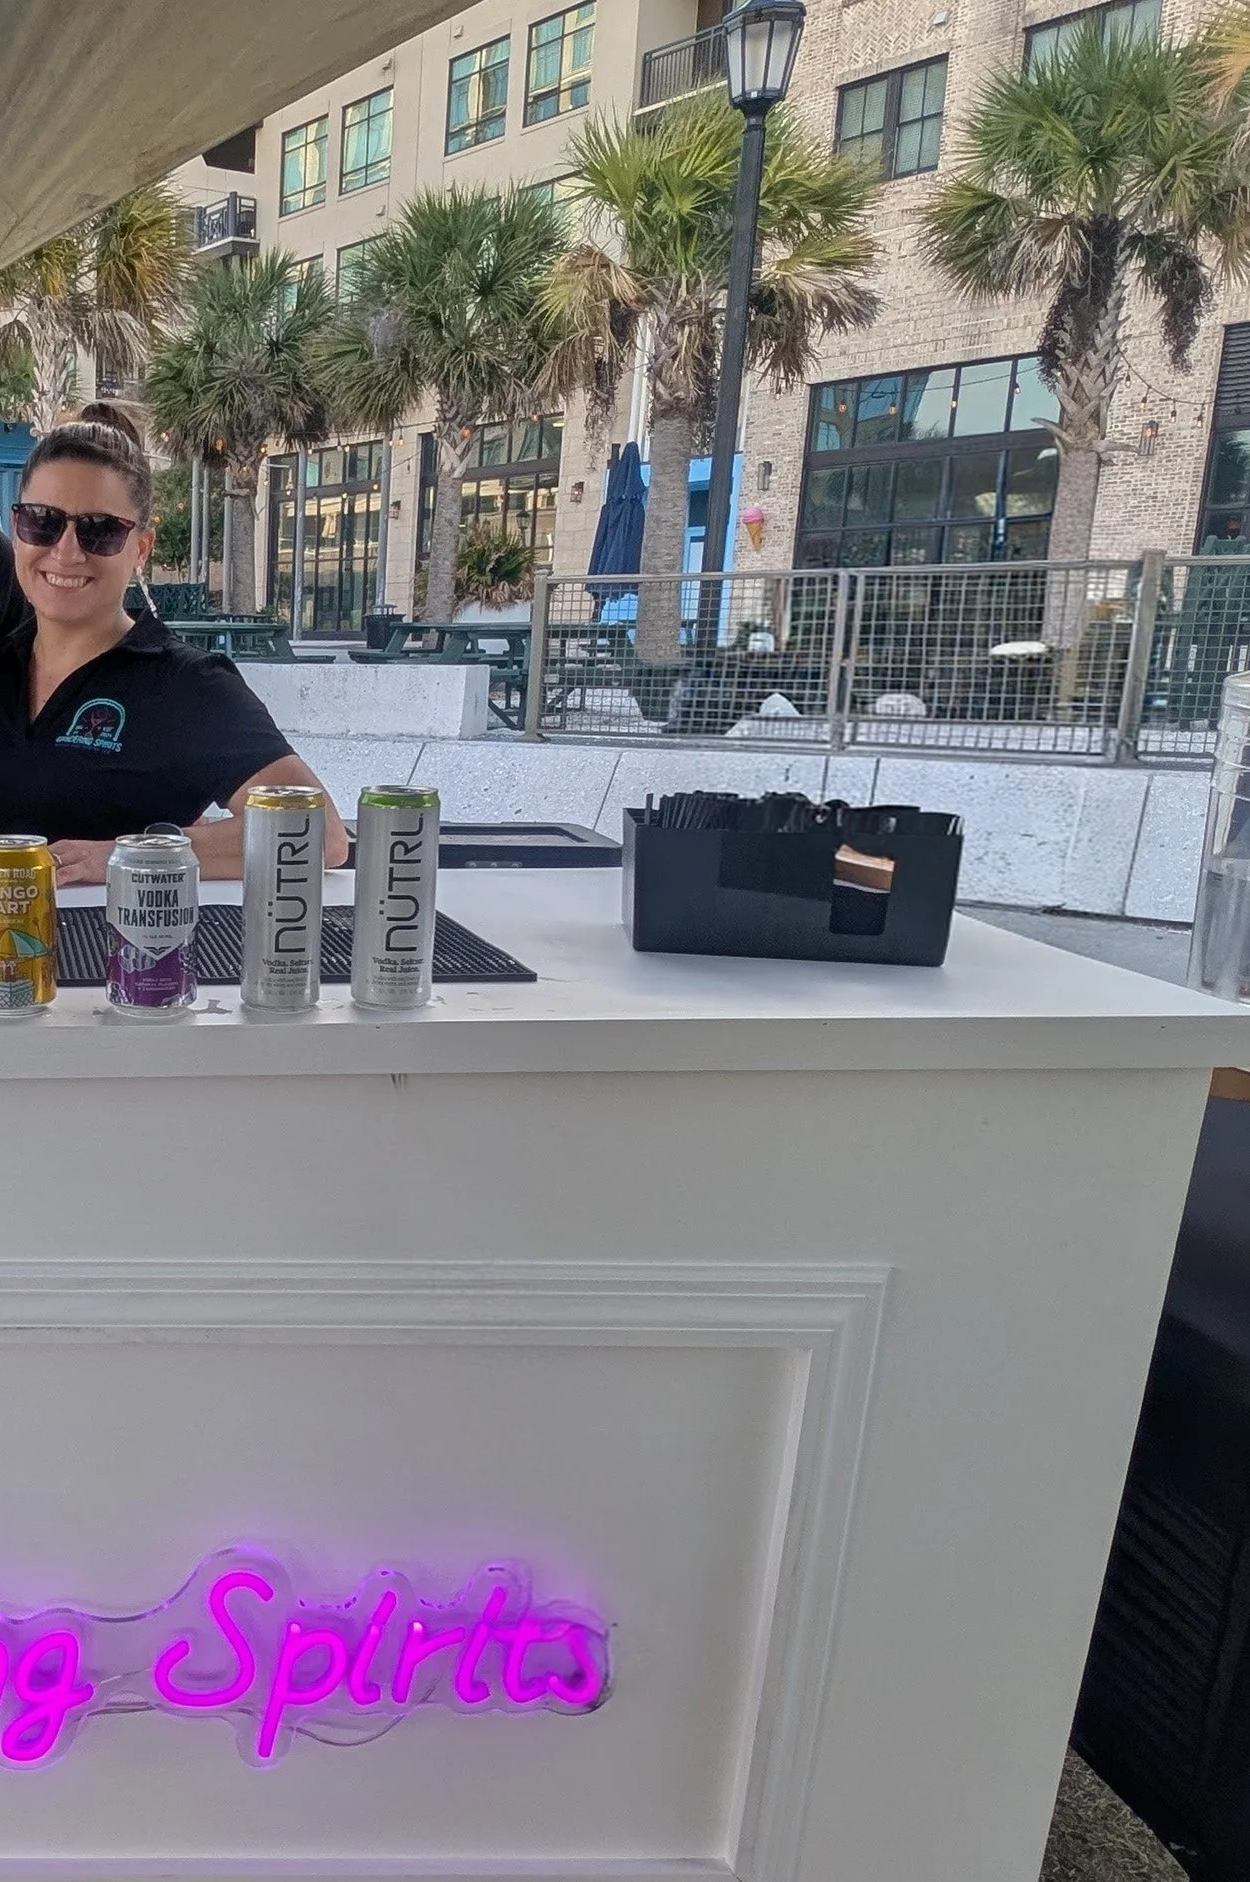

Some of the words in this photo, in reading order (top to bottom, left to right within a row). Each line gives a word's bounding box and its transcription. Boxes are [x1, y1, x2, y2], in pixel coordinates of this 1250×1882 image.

[12, 868, 37, 880] ROAD
[131, 872, 186, 884] CUTWATER
[137, 889, 180, 908] VODKA
[117, 906, 195, 928] TRANSFUSION
[153, 1570, 603, 1759] Spirits
